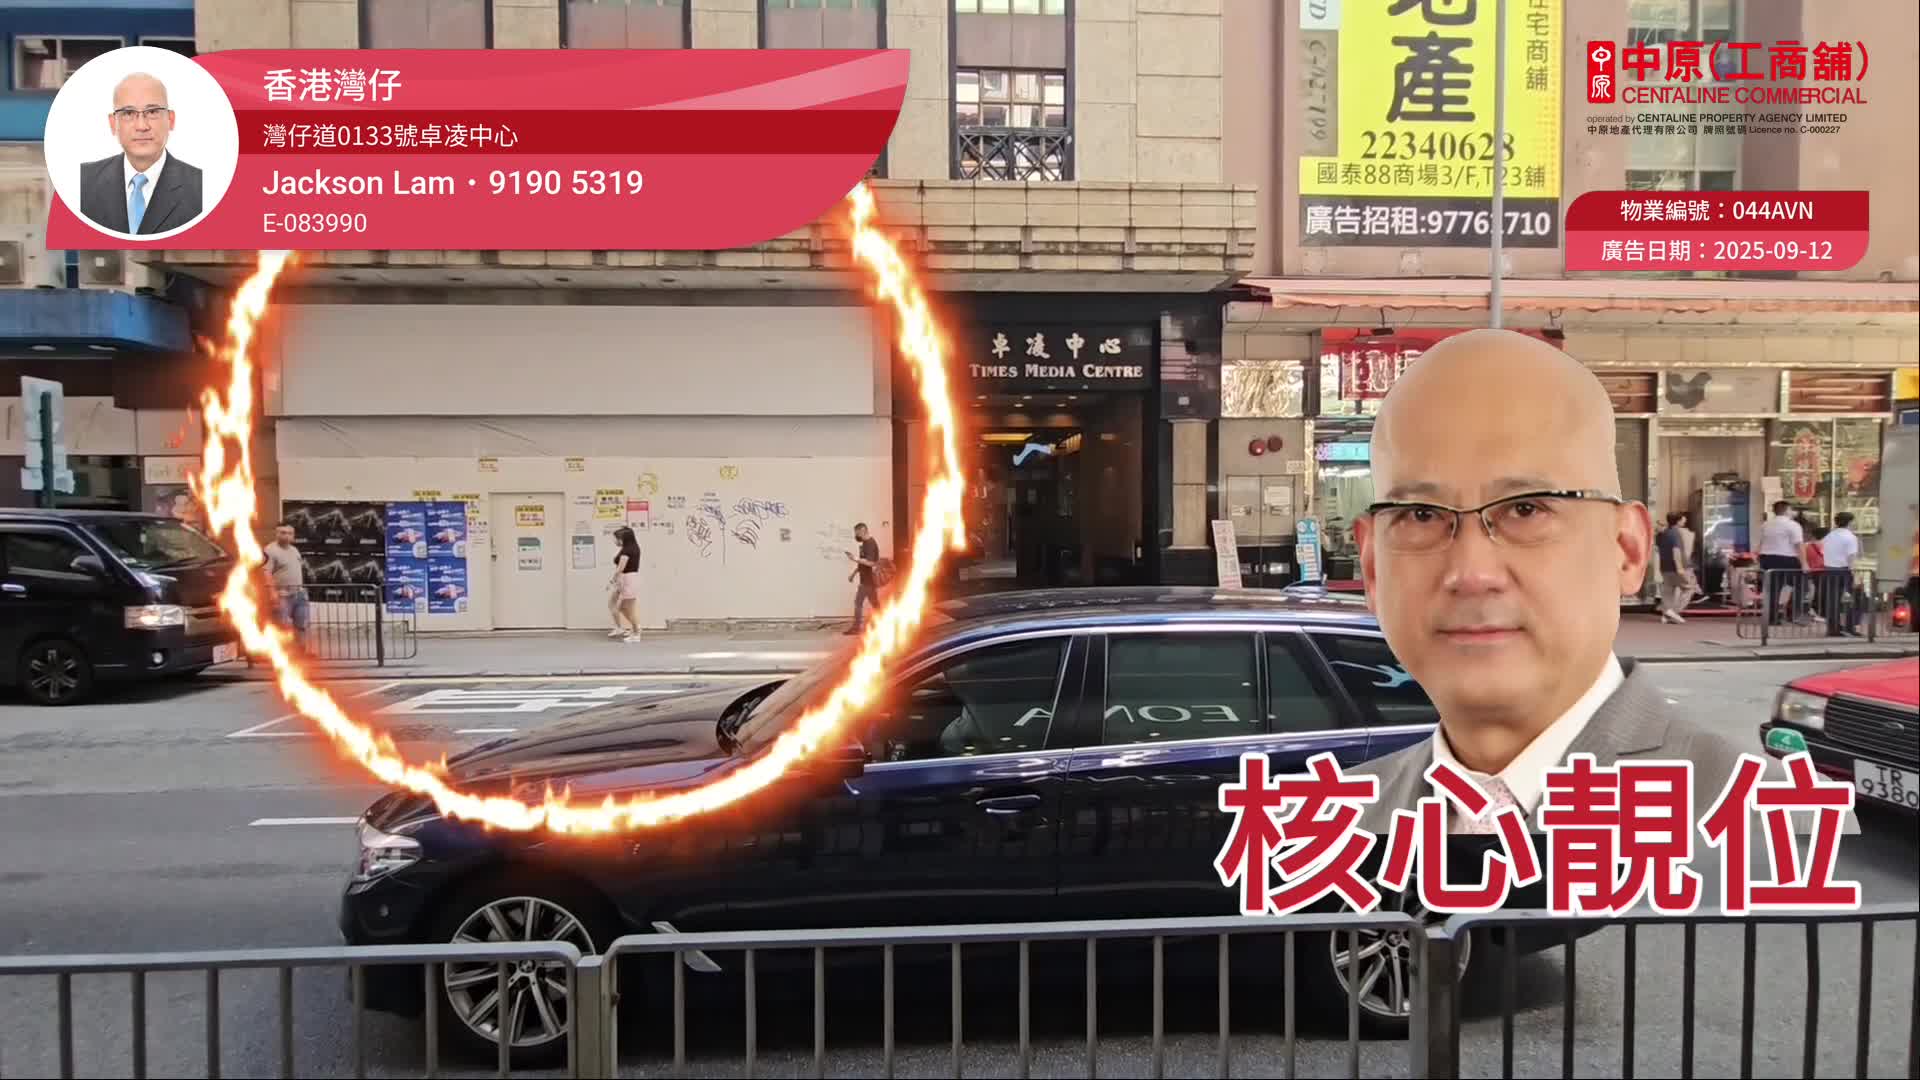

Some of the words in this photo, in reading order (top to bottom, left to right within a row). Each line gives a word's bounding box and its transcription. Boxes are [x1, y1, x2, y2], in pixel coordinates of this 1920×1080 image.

[1386, 0, 1477, 123] 產
[992, 332, 1121, 359] 卓凌中心
[1876, 765, 1903, 788] TR
[1861, 778, 1919, 808] 9380
